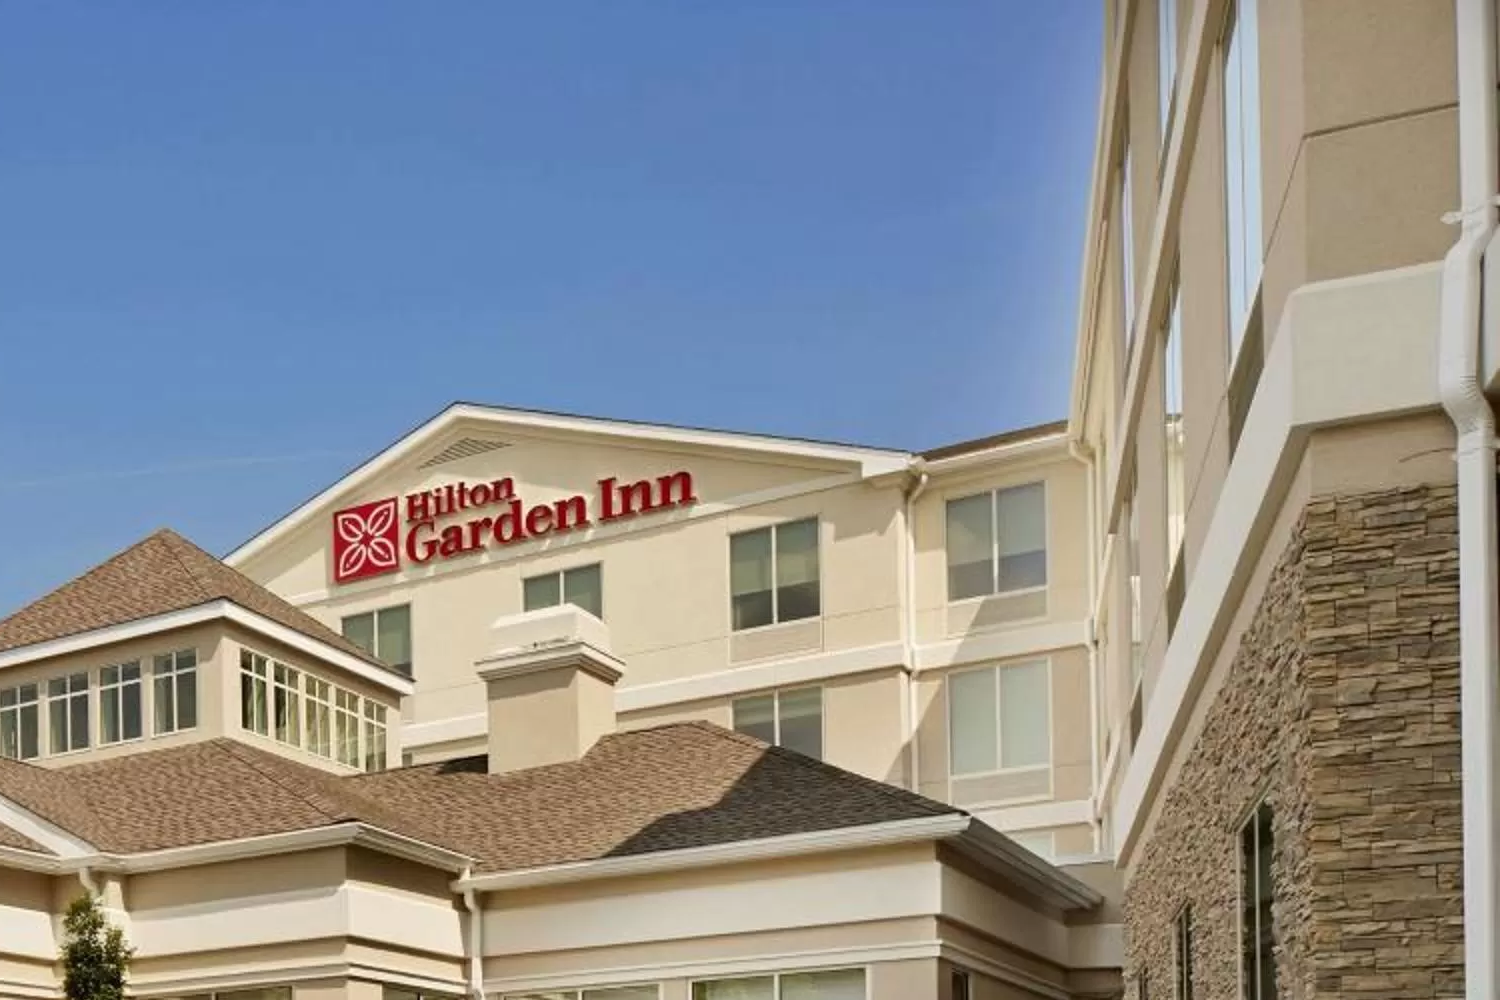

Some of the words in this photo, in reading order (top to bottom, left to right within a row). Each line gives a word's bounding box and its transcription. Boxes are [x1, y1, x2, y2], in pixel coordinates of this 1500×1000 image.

[405, 476, 515, 523] Hilton
[405, 494, 590, 565] Garden
[597, 470, 697, 521] Inn
